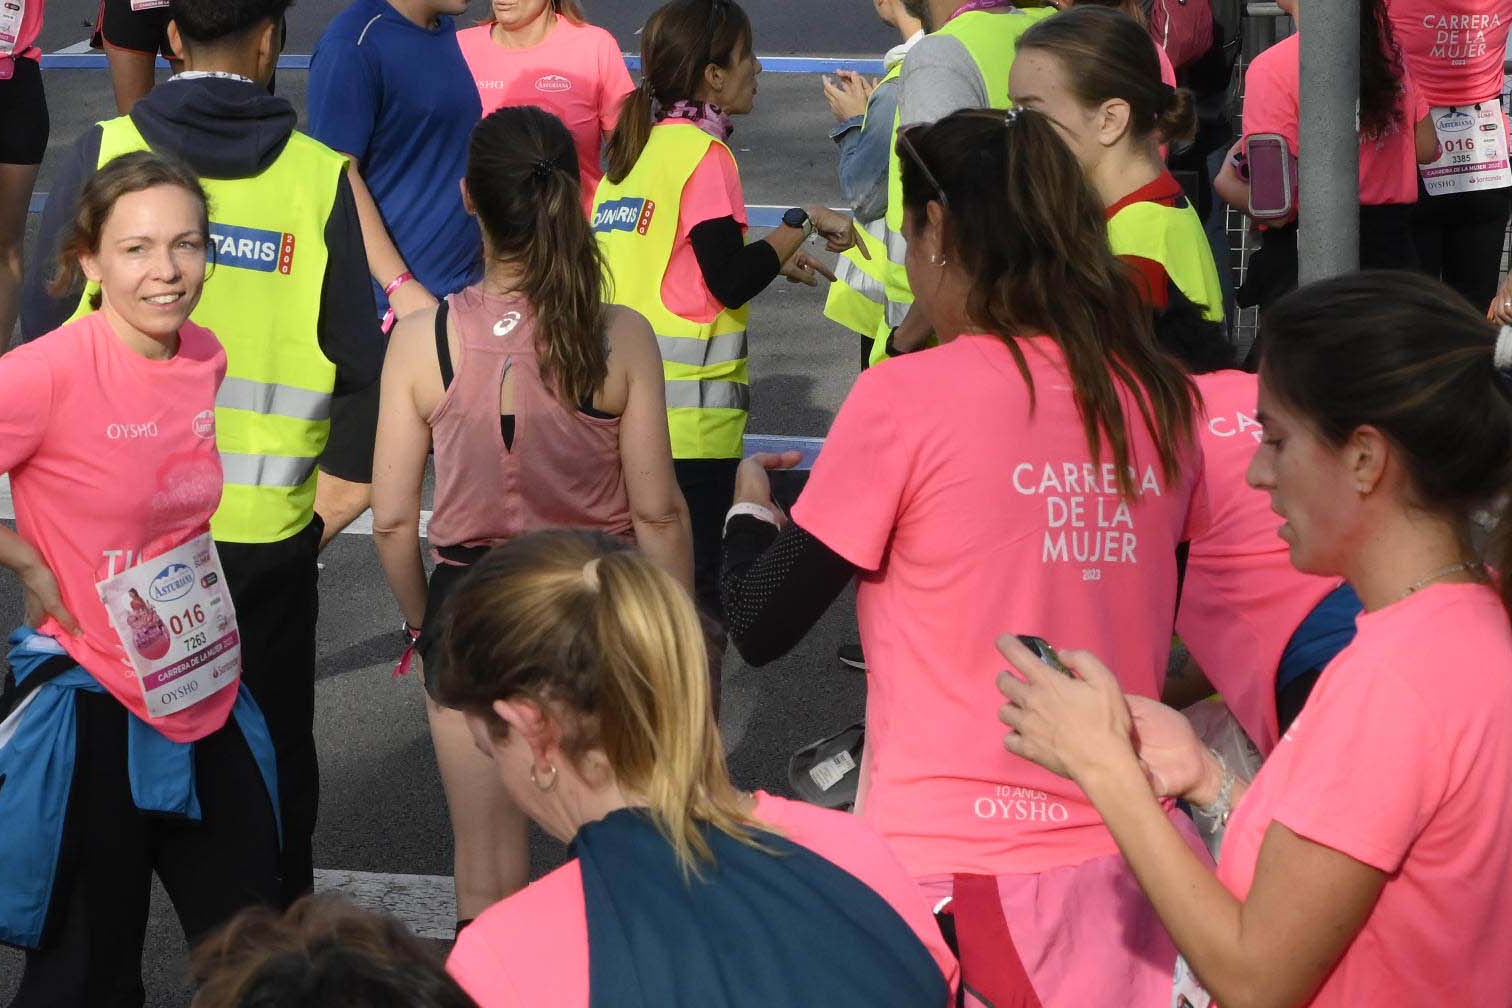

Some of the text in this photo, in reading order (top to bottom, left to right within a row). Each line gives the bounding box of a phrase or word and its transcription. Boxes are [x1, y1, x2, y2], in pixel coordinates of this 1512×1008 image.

[1423, 14, 1501, 30] CARRERA
[1437, 30, 1486, 43] DE LA
[1430, 44, 1487, 58] MUJER
[1444, 138, 1475, 153] 016
[639, 201, 654, 234] 2000
[281, 235, 293, 273] 2000
[105, 421, 159, 440] OYSHO
[1047, 496, 1135, 530] DE LA
[1042, 531, 1138, 564] MUJER
[169, 603, 206, 635] 016
[183, 631, 208, 652] 7263
[157, 663, 191, 683] CARRERA
[190, 656, 200, 667] DE
[199, 652, 209, 662] LA
[161, 679, 199, 706] OYSHO
[974, 797, 1069, 824] OYSHO
